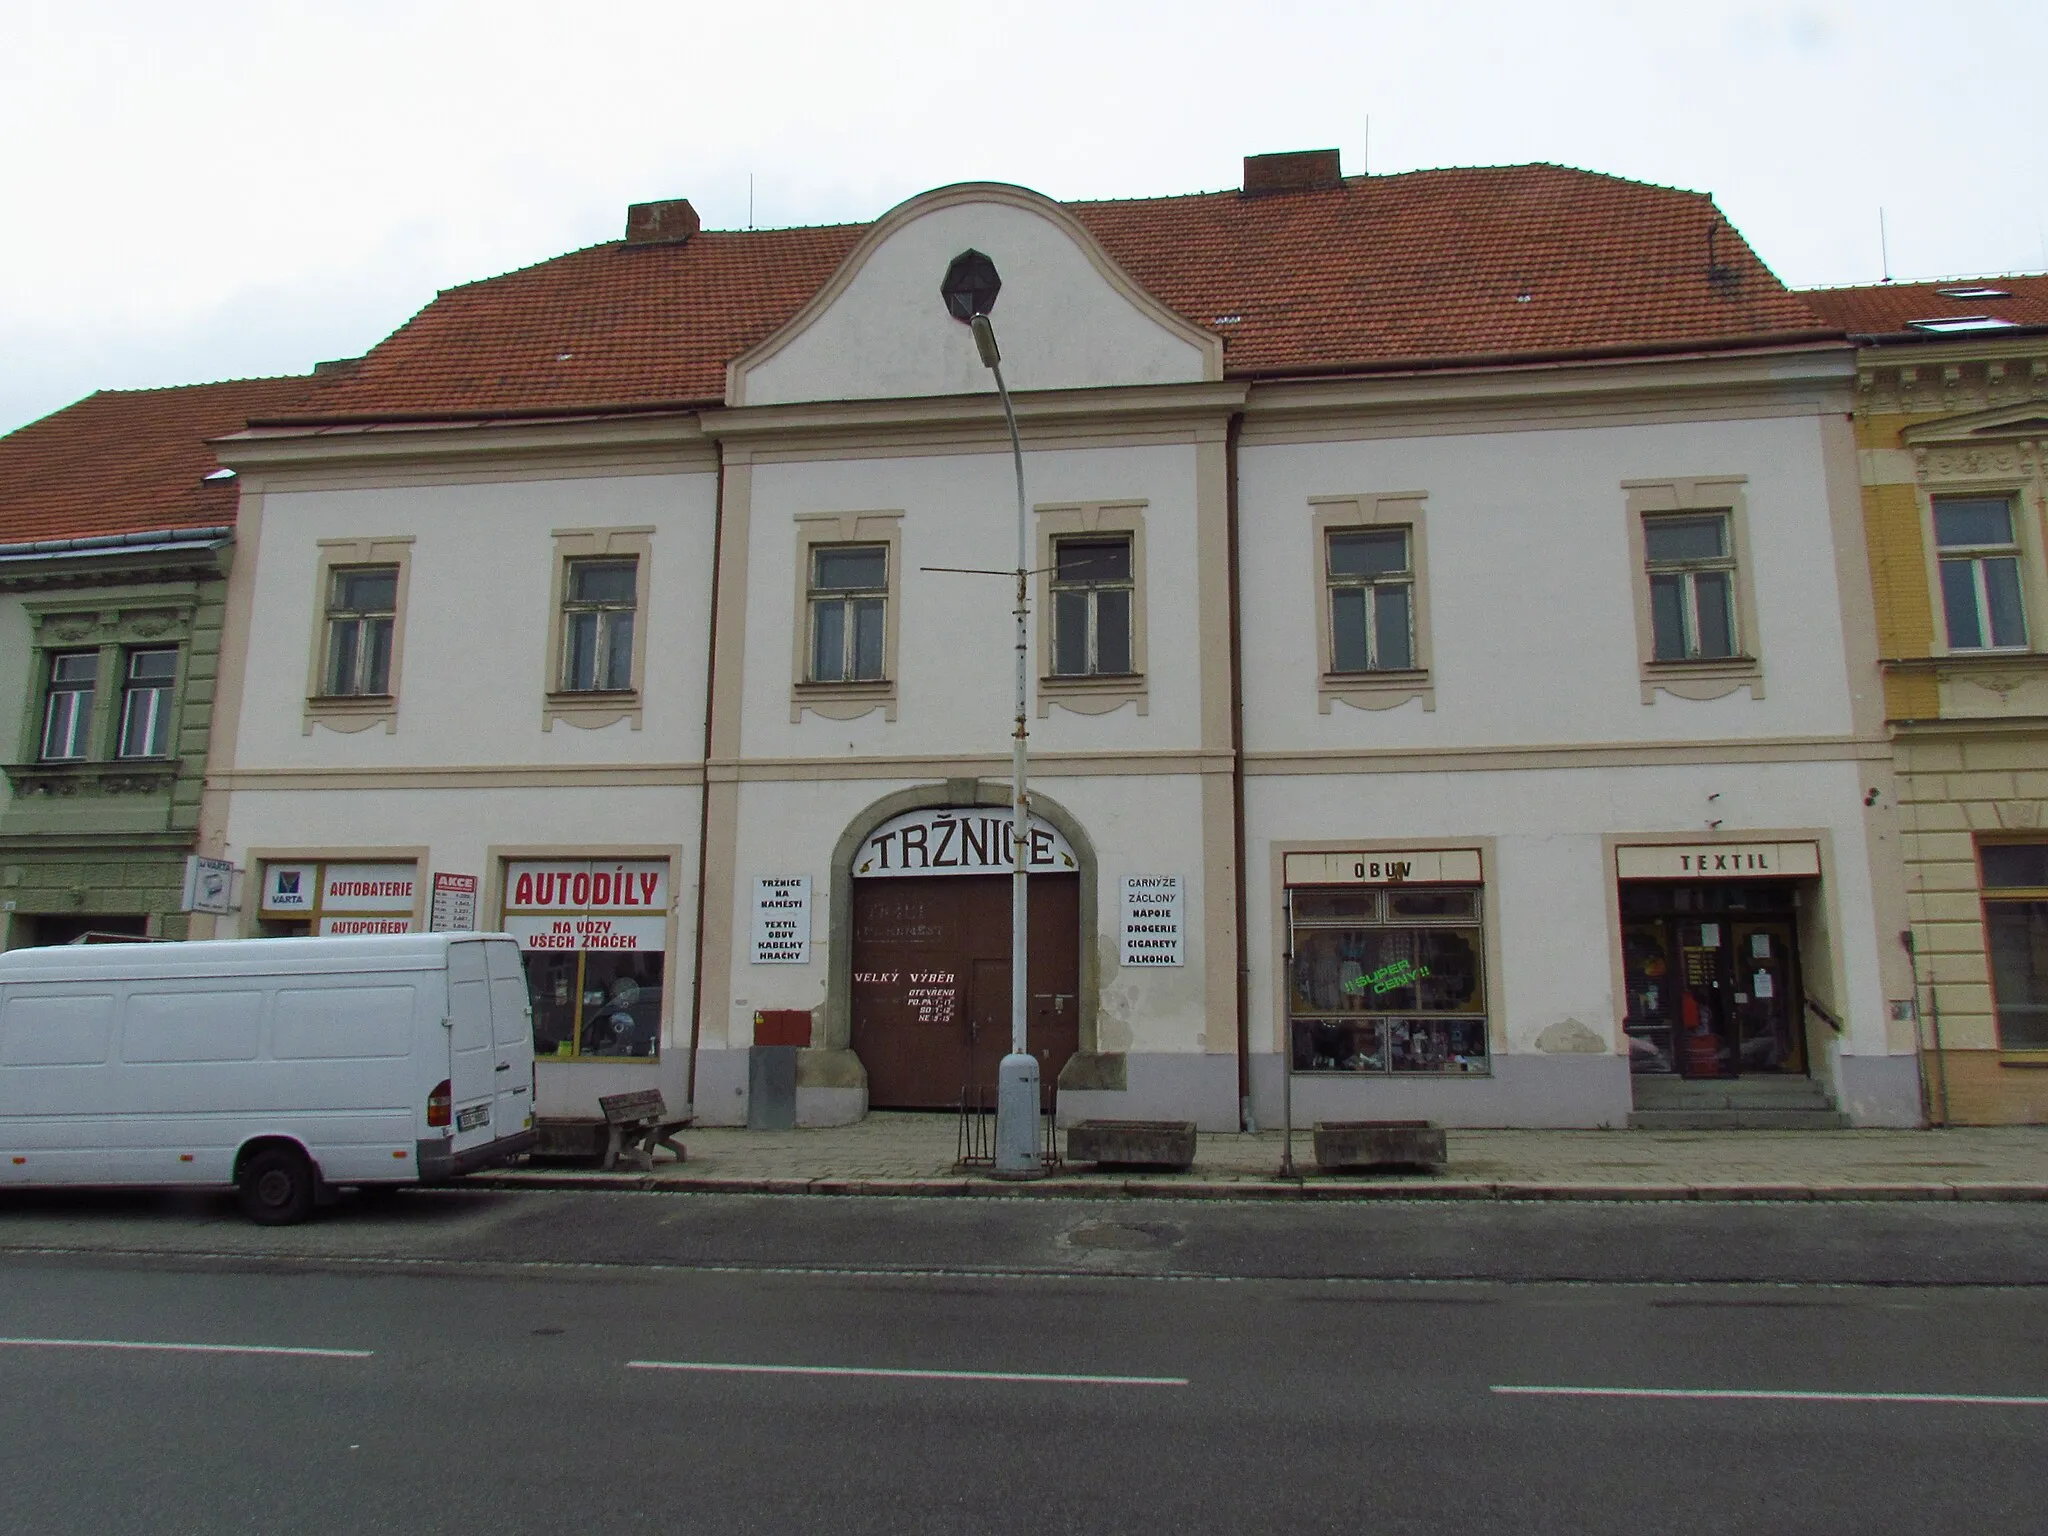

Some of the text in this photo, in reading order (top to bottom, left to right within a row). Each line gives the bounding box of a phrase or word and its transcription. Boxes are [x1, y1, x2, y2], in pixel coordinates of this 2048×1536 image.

[1680, 853, 1768, 870] TEXTIL
[1354, 861, 1411, 878] OBUV
[438, 876, 473, 888] AKCE
[514, 865, 658, 905] AUTODÍLY
[761, 877, 801, 887] TRŽNICE
[1128, 875, 1176, 887] GARNÝŽE
[330, 882, 413, 897] AUTOBATERIE
[272, 895, 303, 904] VARTA
[1128, 891, 1176, 903] ZÁCLONY
[331, 919, 409, 934] AUTOPOTŘEBY
[552, 921, 612, 934] NA VOZY
[764, 921, 797, 929] TEXTIL
[1127, 924, 1177, 933] DROGERIE
[529, 932, 637, 948] VŠECH ZNAČEK
[758, 941, 803, 949] KABELKY
[1127, 940, 1177, 948] CIGARETY
[759, 951, 801, 960] HRAČKY
[1128, 955, 1176, 963] ALKOHOL
[854, 969, 955, 983] VELKÝ VÝBĚR
[1356, 959, 1411, 987] SUPER
[1373, 969, 1417, 994] CENY
[908, 986, 956, 996] OTEVŘENO
